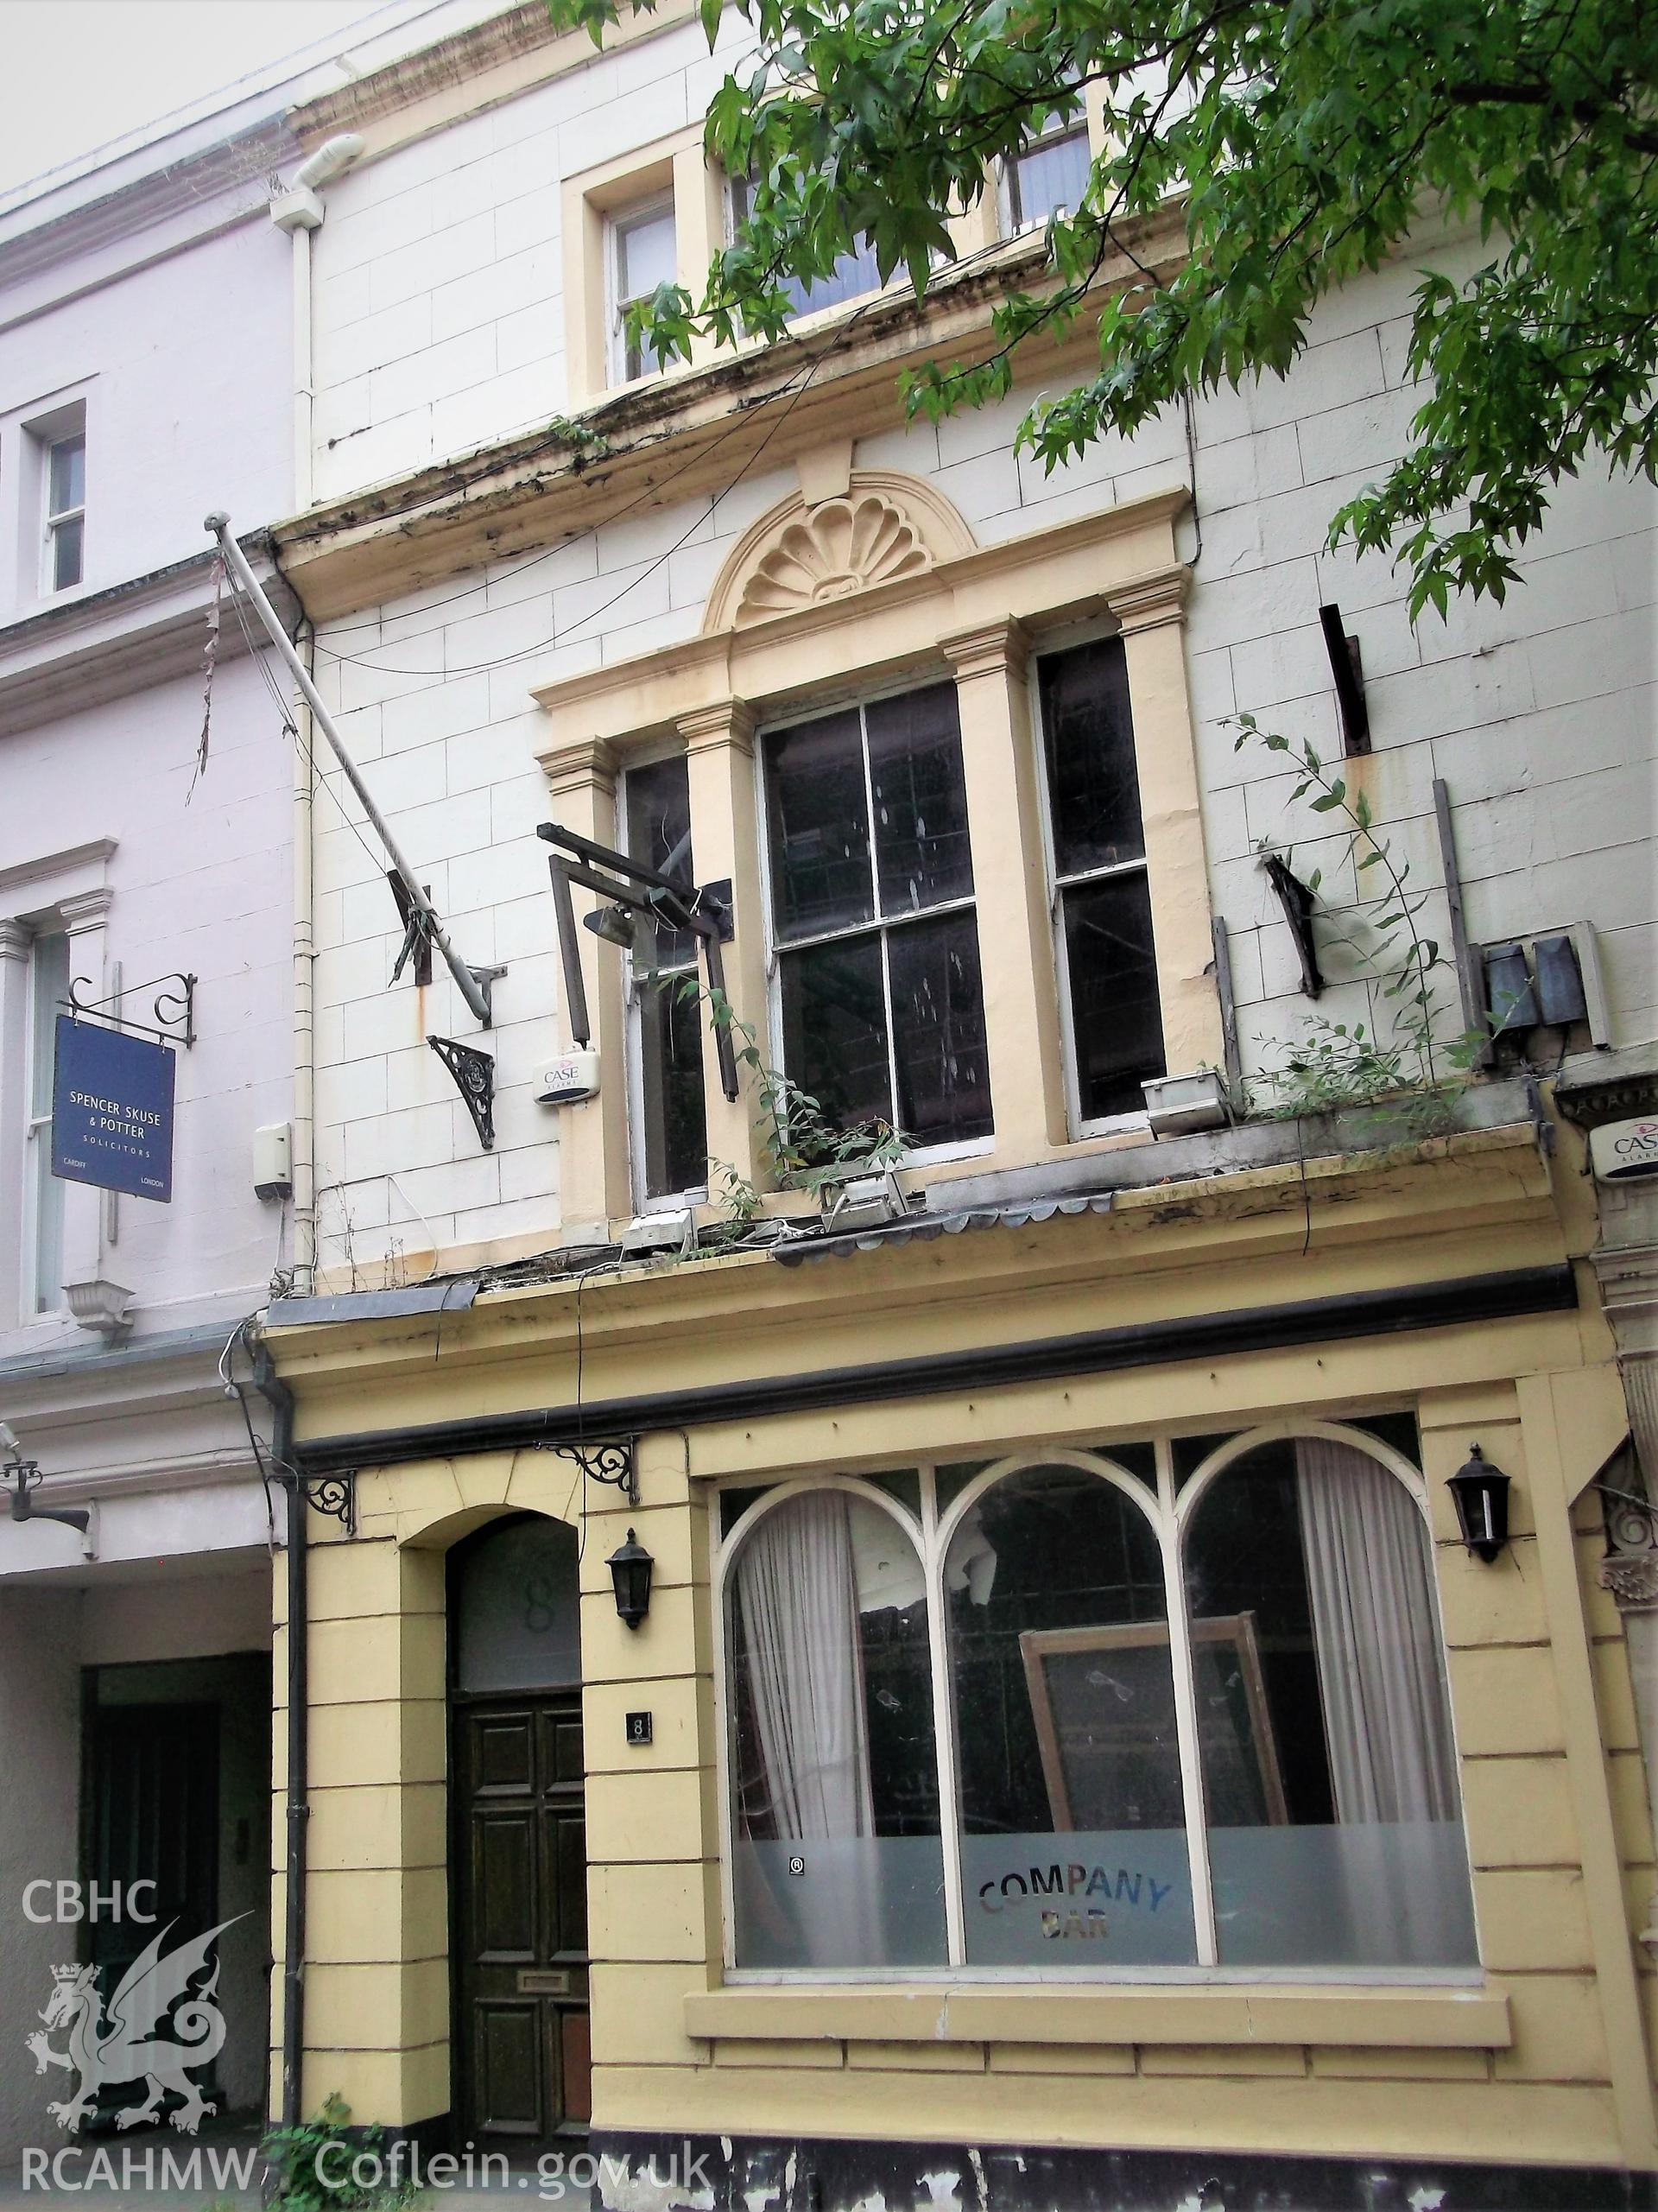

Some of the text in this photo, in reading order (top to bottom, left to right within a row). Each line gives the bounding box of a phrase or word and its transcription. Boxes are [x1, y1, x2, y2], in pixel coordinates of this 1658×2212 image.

[544, 1066, 579, 1084] CASE
[69, 1091, 161, 1126] SPENCER SKUSE
[89, 1116, 145, 1140] & POTTER
[83, 1134, 151, 1158] SOLICITORS
[1614, 1133, 1658, 1154] CAS
[63, 1157, 87, 1169] CARDIFF
[141, 1176, 164, 1188] LONDON
[525, 1575, 555, 1634] 8
[634, 1719, 642, 1735] 8
[978, 1863, 1174, 1914] COMPANY
[1041, 1908, 1109, 1939] BAR
